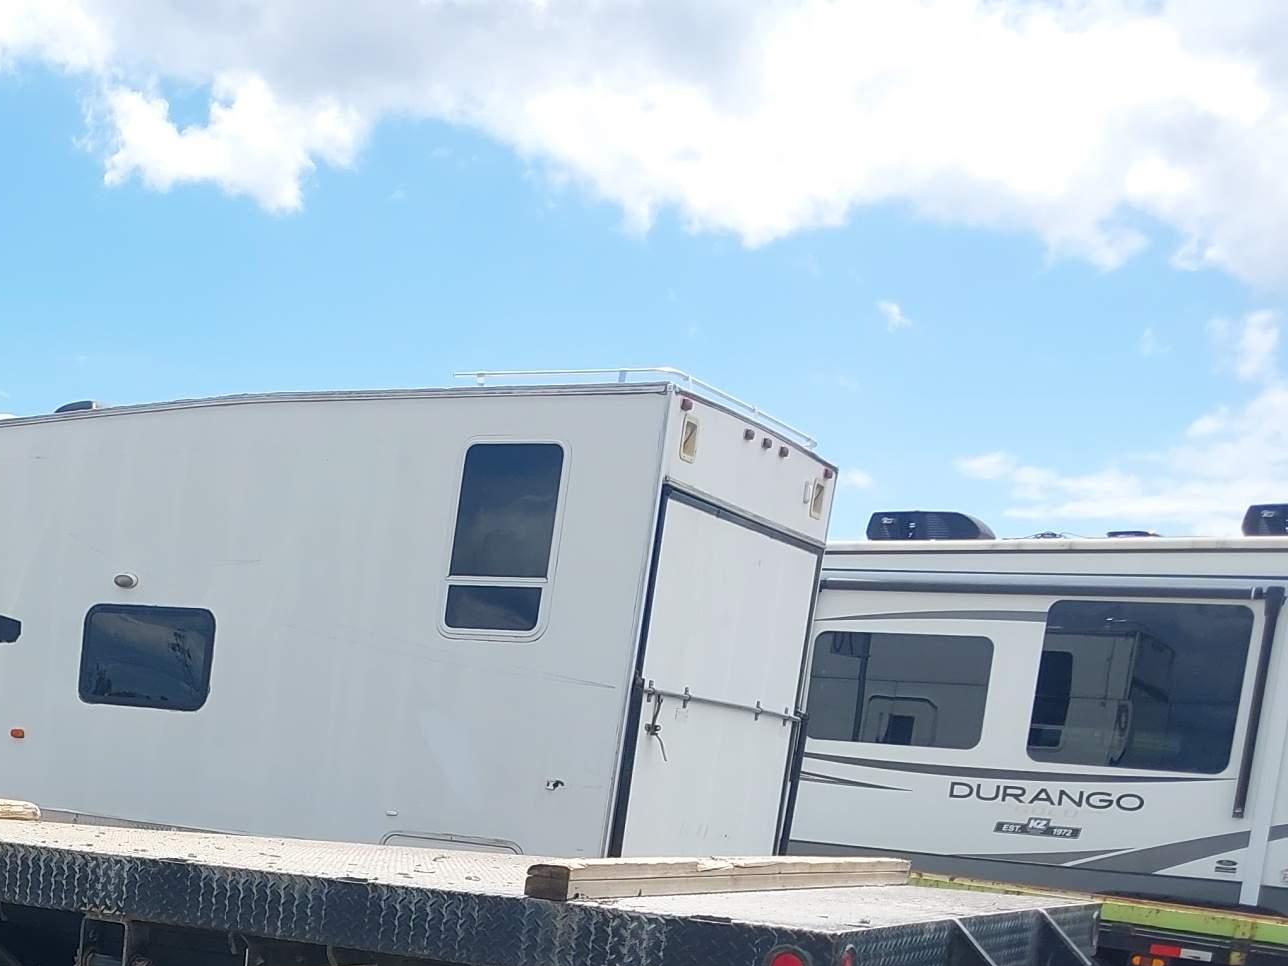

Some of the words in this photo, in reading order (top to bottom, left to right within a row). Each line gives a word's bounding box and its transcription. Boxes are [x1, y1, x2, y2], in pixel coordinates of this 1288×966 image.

[949, 781, 1145, 811] DURANGO
[1002, 824, 1022, 833] EST.
[1052, 828, 1073, 837] 1972
